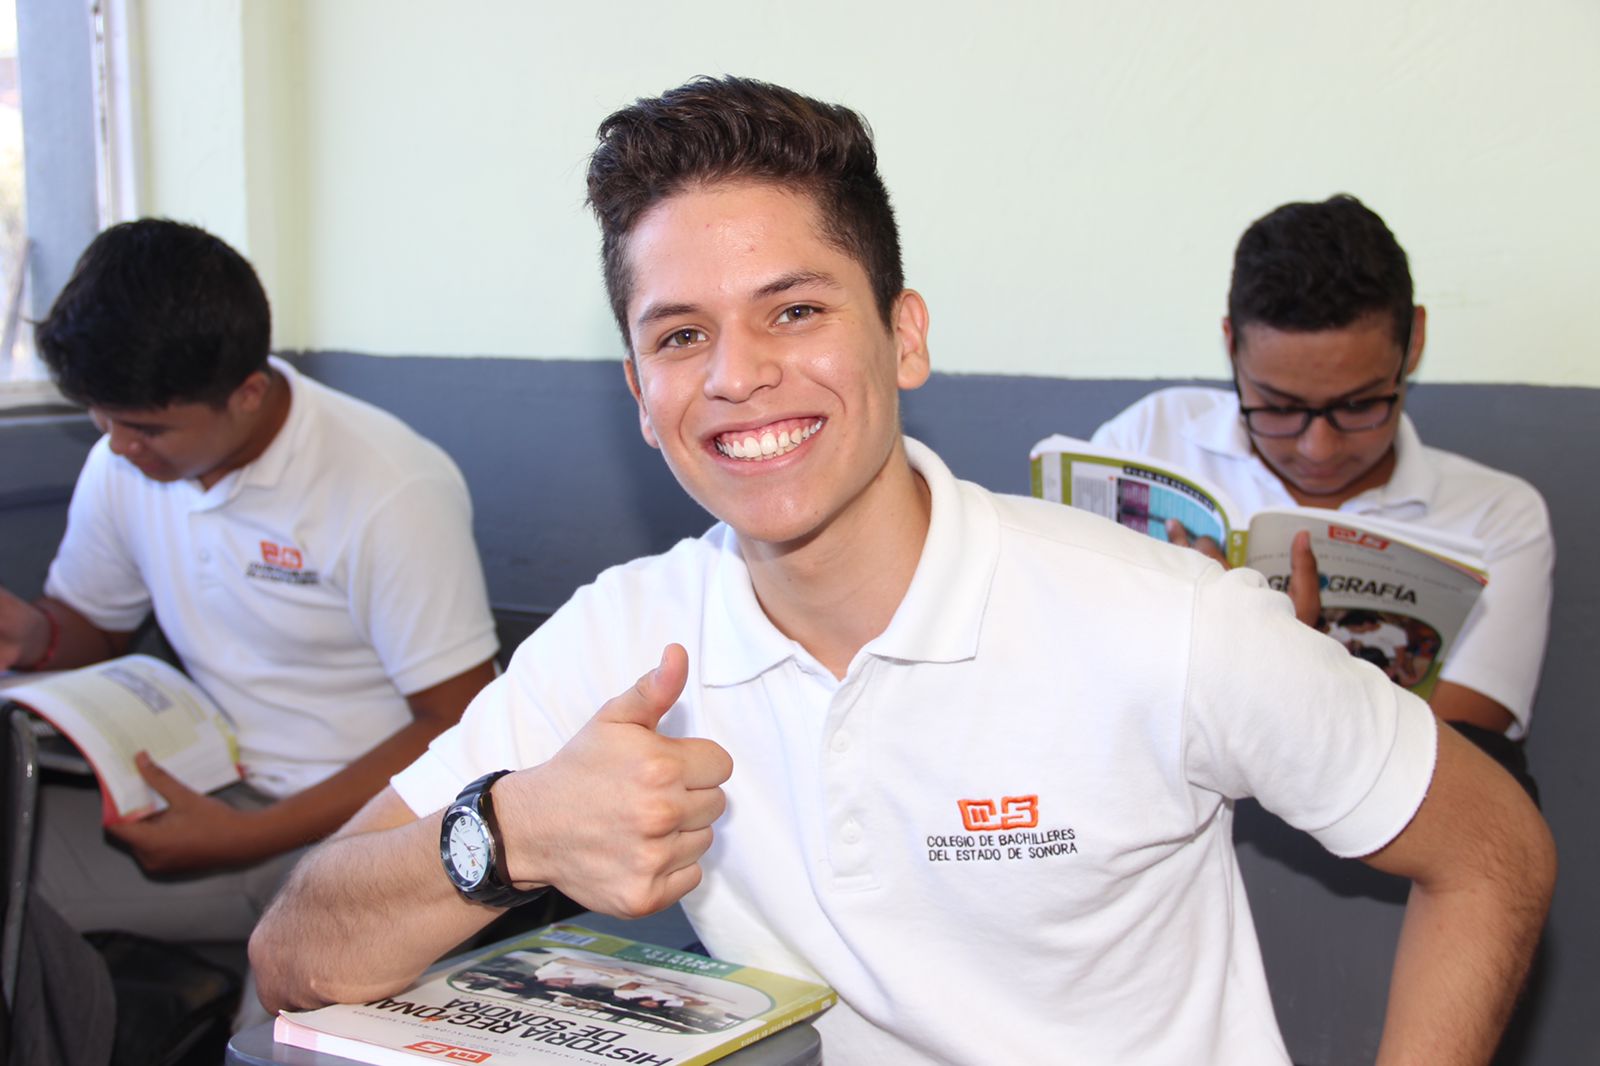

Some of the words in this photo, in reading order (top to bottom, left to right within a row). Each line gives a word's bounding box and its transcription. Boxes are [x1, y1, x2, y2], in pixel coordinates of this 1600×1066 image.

[927, 835, 975, 848] COLEGIO
[979, 835, 994, 847] DE
[999, 828, 1076, 846] BACHILLERES
[928, 849, 951, 861] DEL
[956, 848, 1001, 861] ESTADO
[1008, 847, 1022, 860] DE
[1029, 842, 1078, 859] SONORA
[443, 999, 577, 1031] SONORA
[570, 1025, 627, 1043] DE
[519, 1026, 673, 1066] HISTORIA
